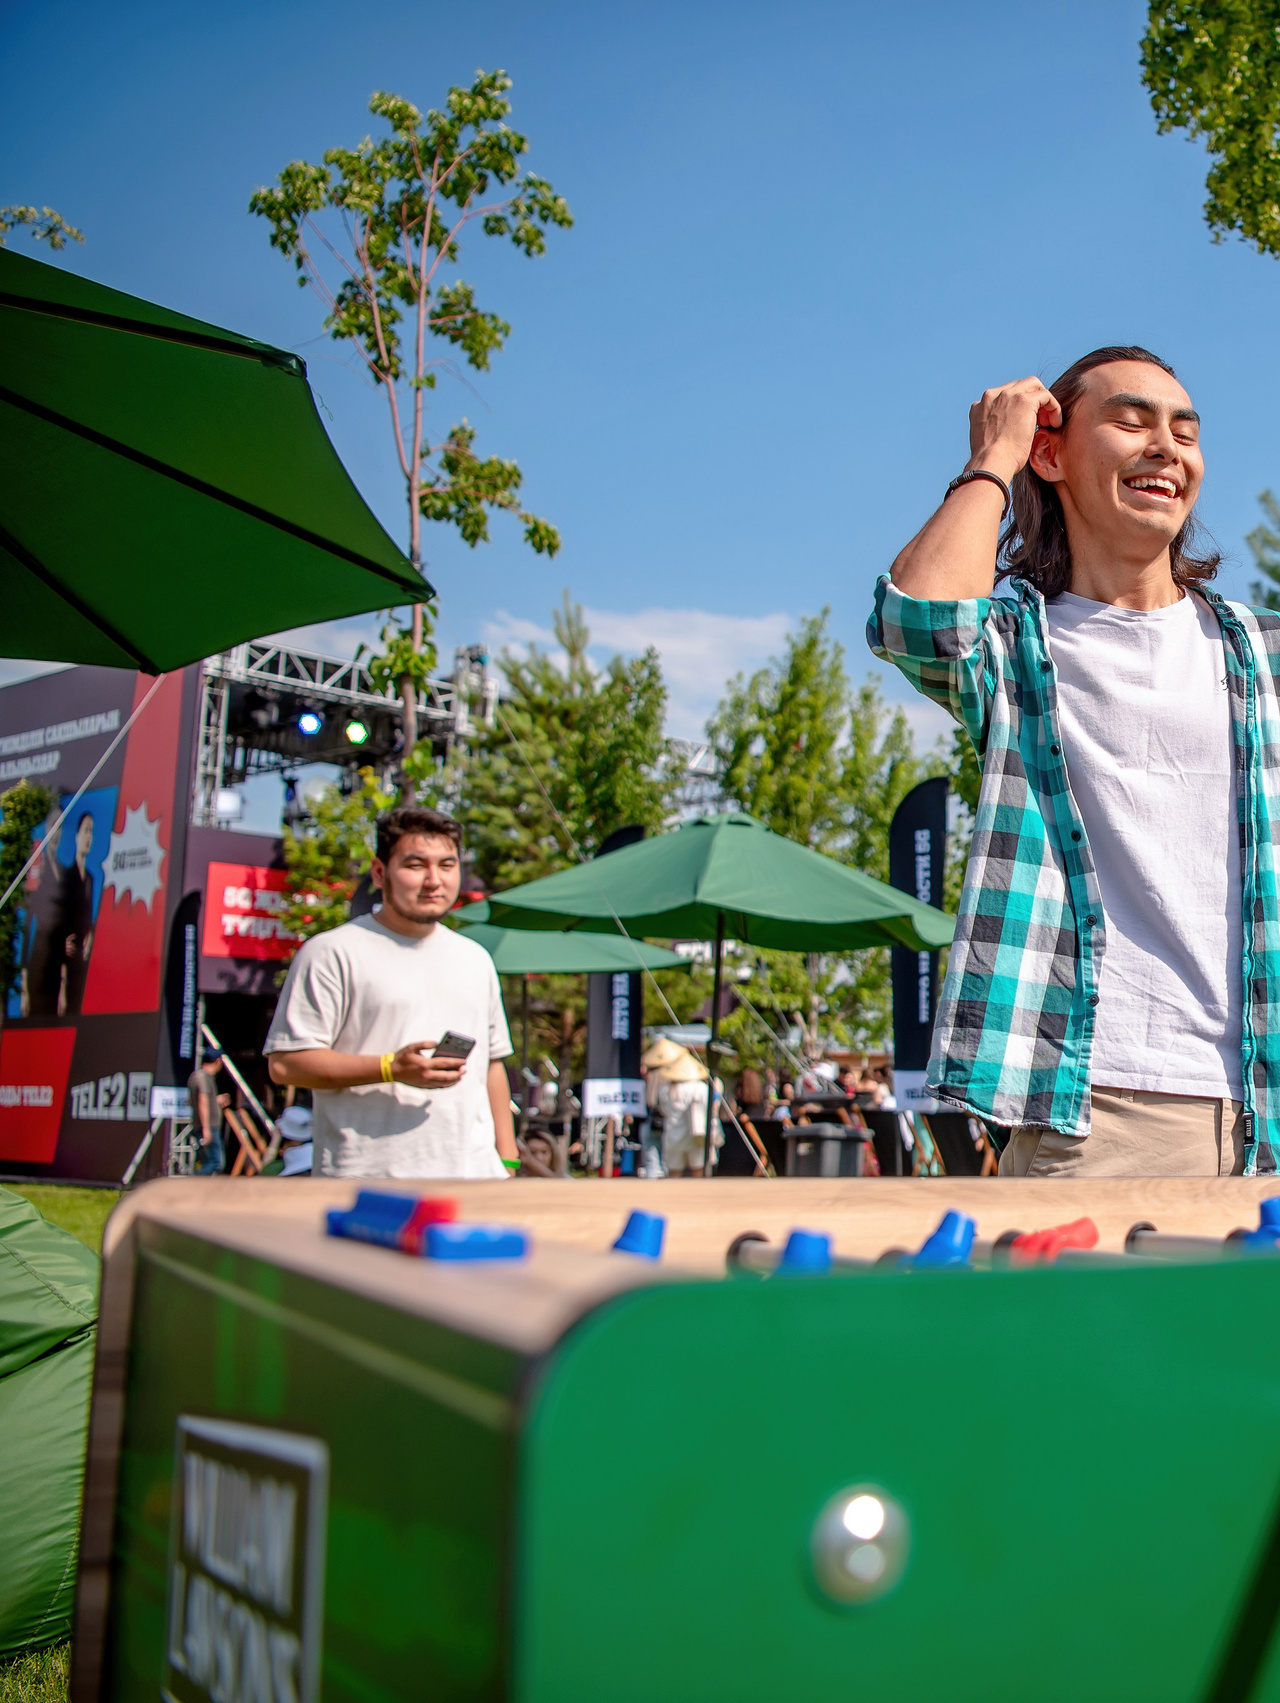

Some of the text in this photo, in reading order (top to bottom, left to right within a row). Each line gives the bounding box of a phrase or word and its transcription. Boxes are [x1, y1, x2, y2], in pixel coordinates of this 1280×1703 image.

[915, 829, 931, 853] 5G
[612, 972, 629, 1040] ЛЕТО НА
[71, 1072, 147, 1121] TELE2 5G
